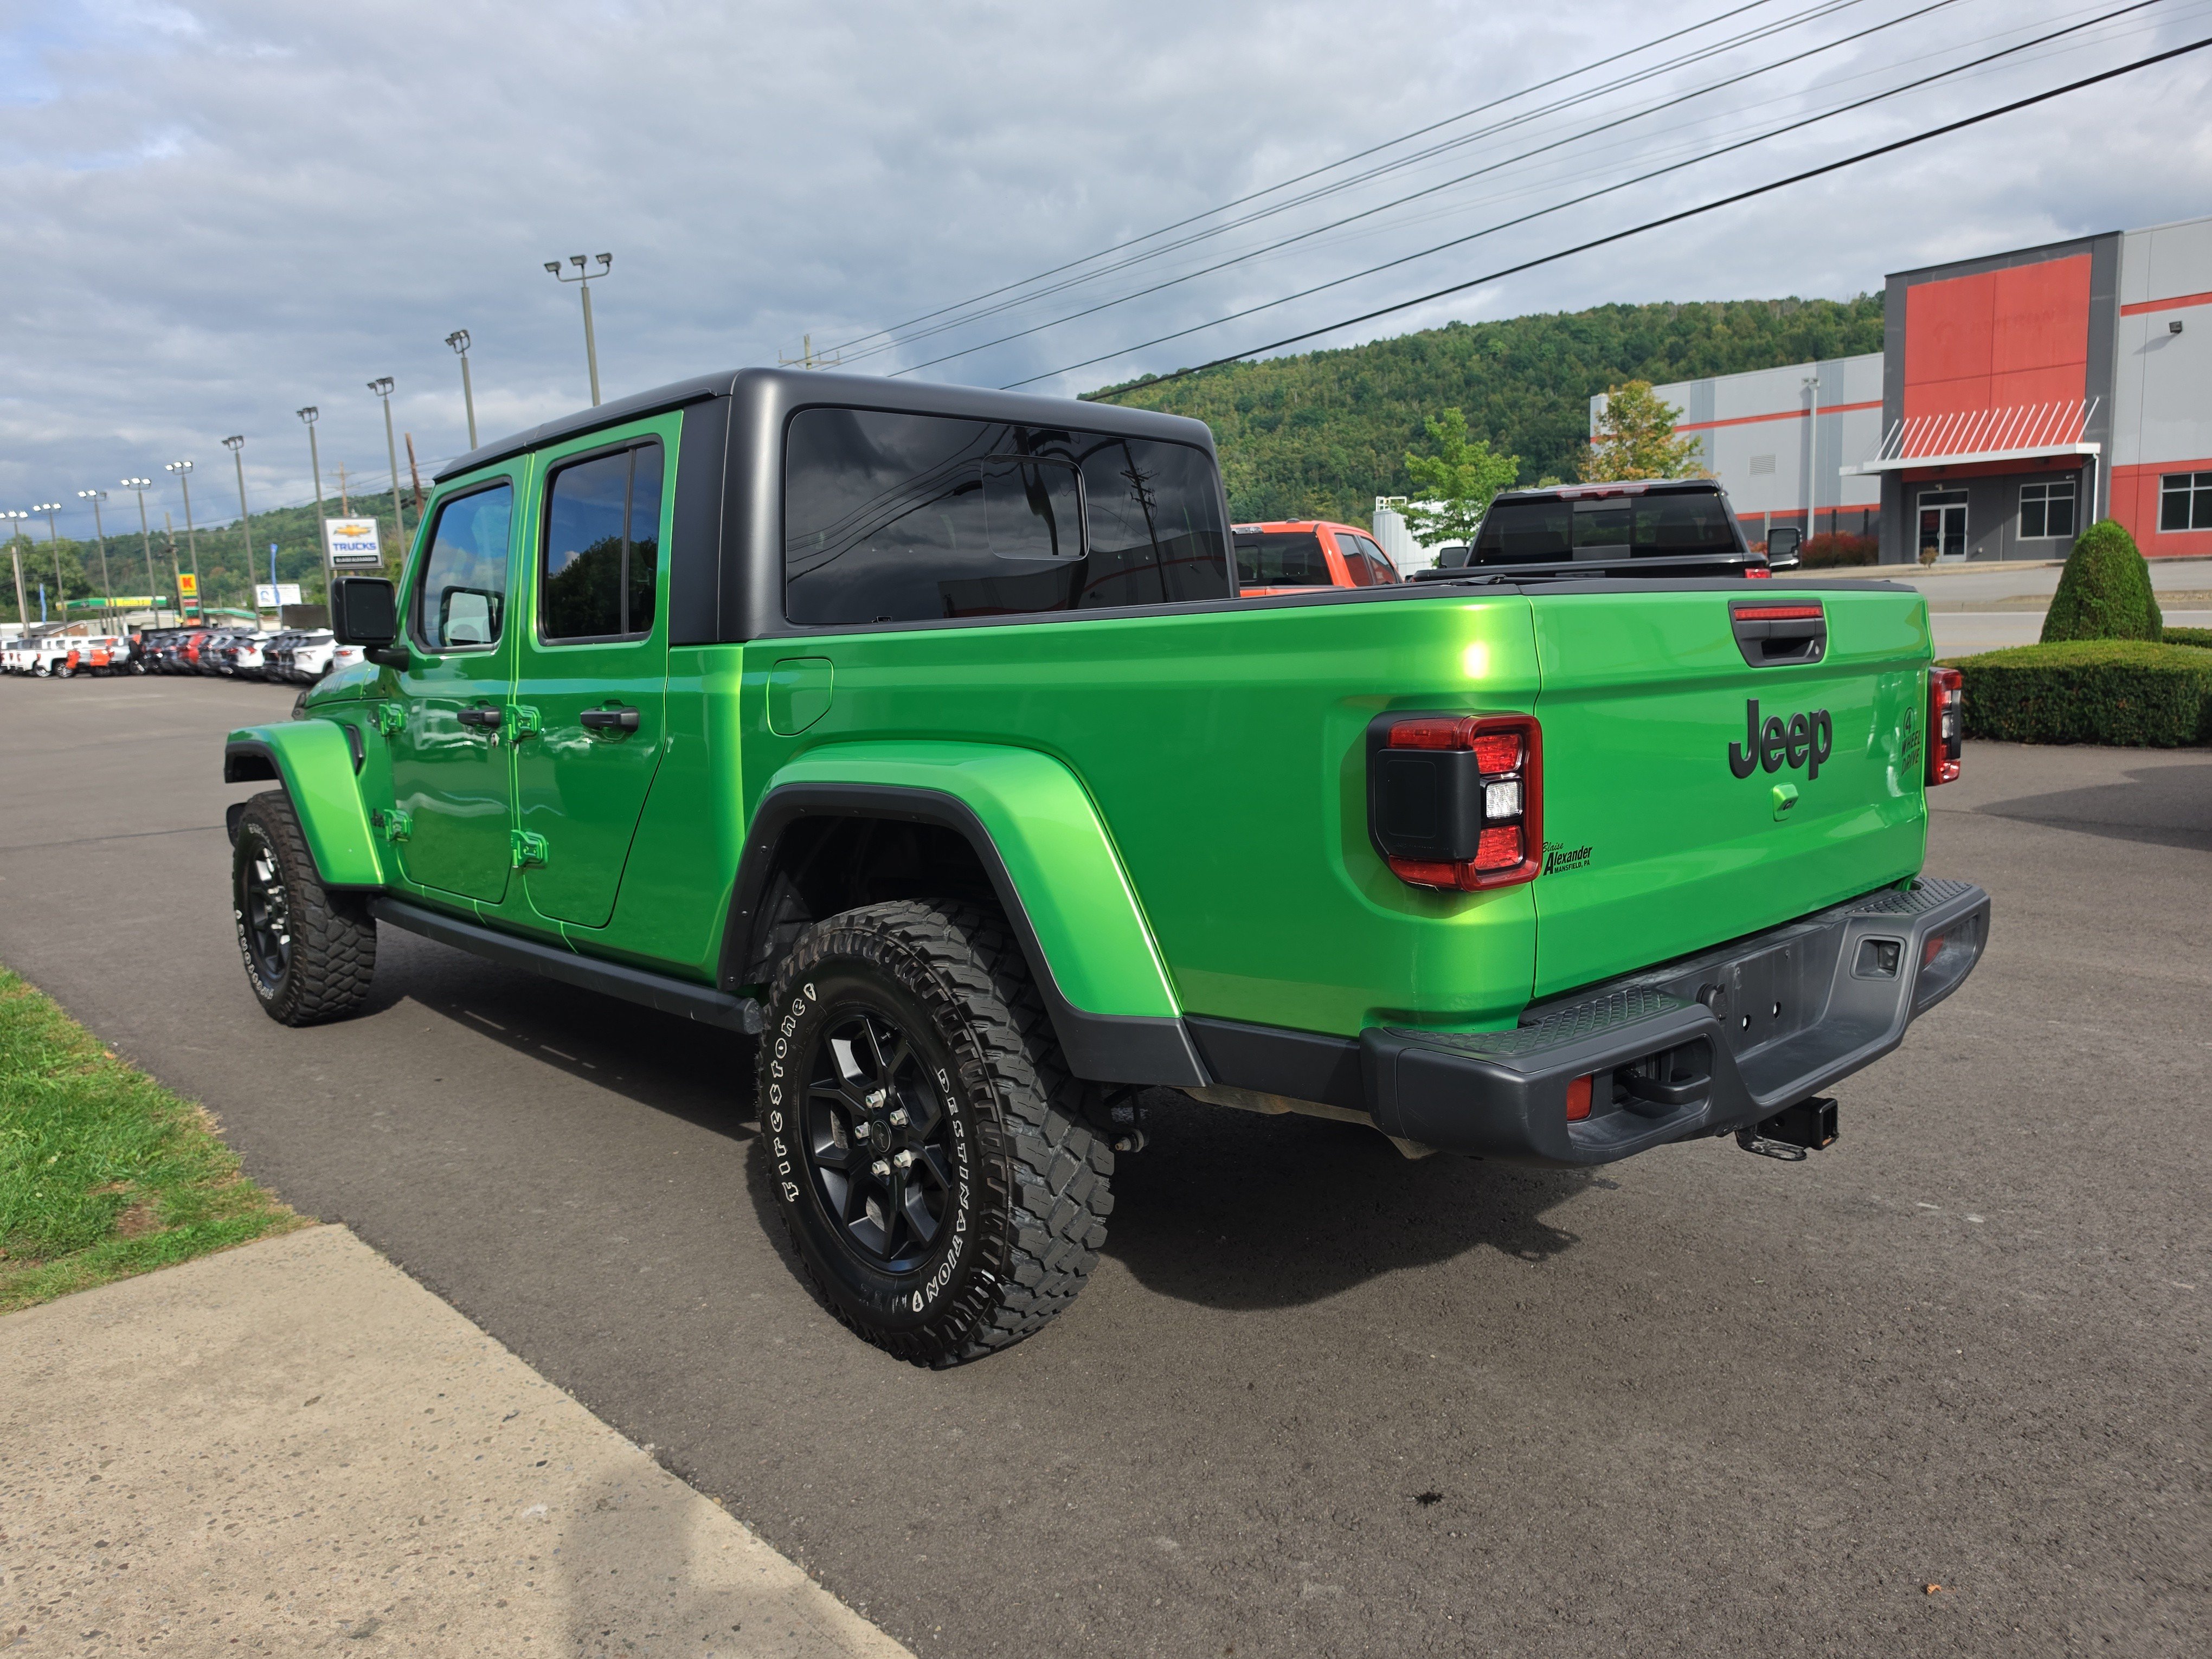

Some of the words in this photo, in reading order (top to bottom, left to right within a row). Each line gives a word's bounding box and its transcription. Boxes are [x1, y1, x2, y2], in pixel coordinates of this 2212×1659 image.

[333, 543, 376, 551] TRUCKS
[182, 577, 193, 589] K
[1729, 698, 1832, 781] Jeep
[1901, 729, 1921, 758] WHEEL
[1901, 747, 1920, 776] DRIVE
[1543, 841, 1564, 853] Blaise
[1543, 845, 1593, 876] Alexander
[1554, 861, 1583, 873] MANSFIELD,
[769, 998, 806, 1203] Firestone
[926, 1068, 970, 1303] DESTINATION
